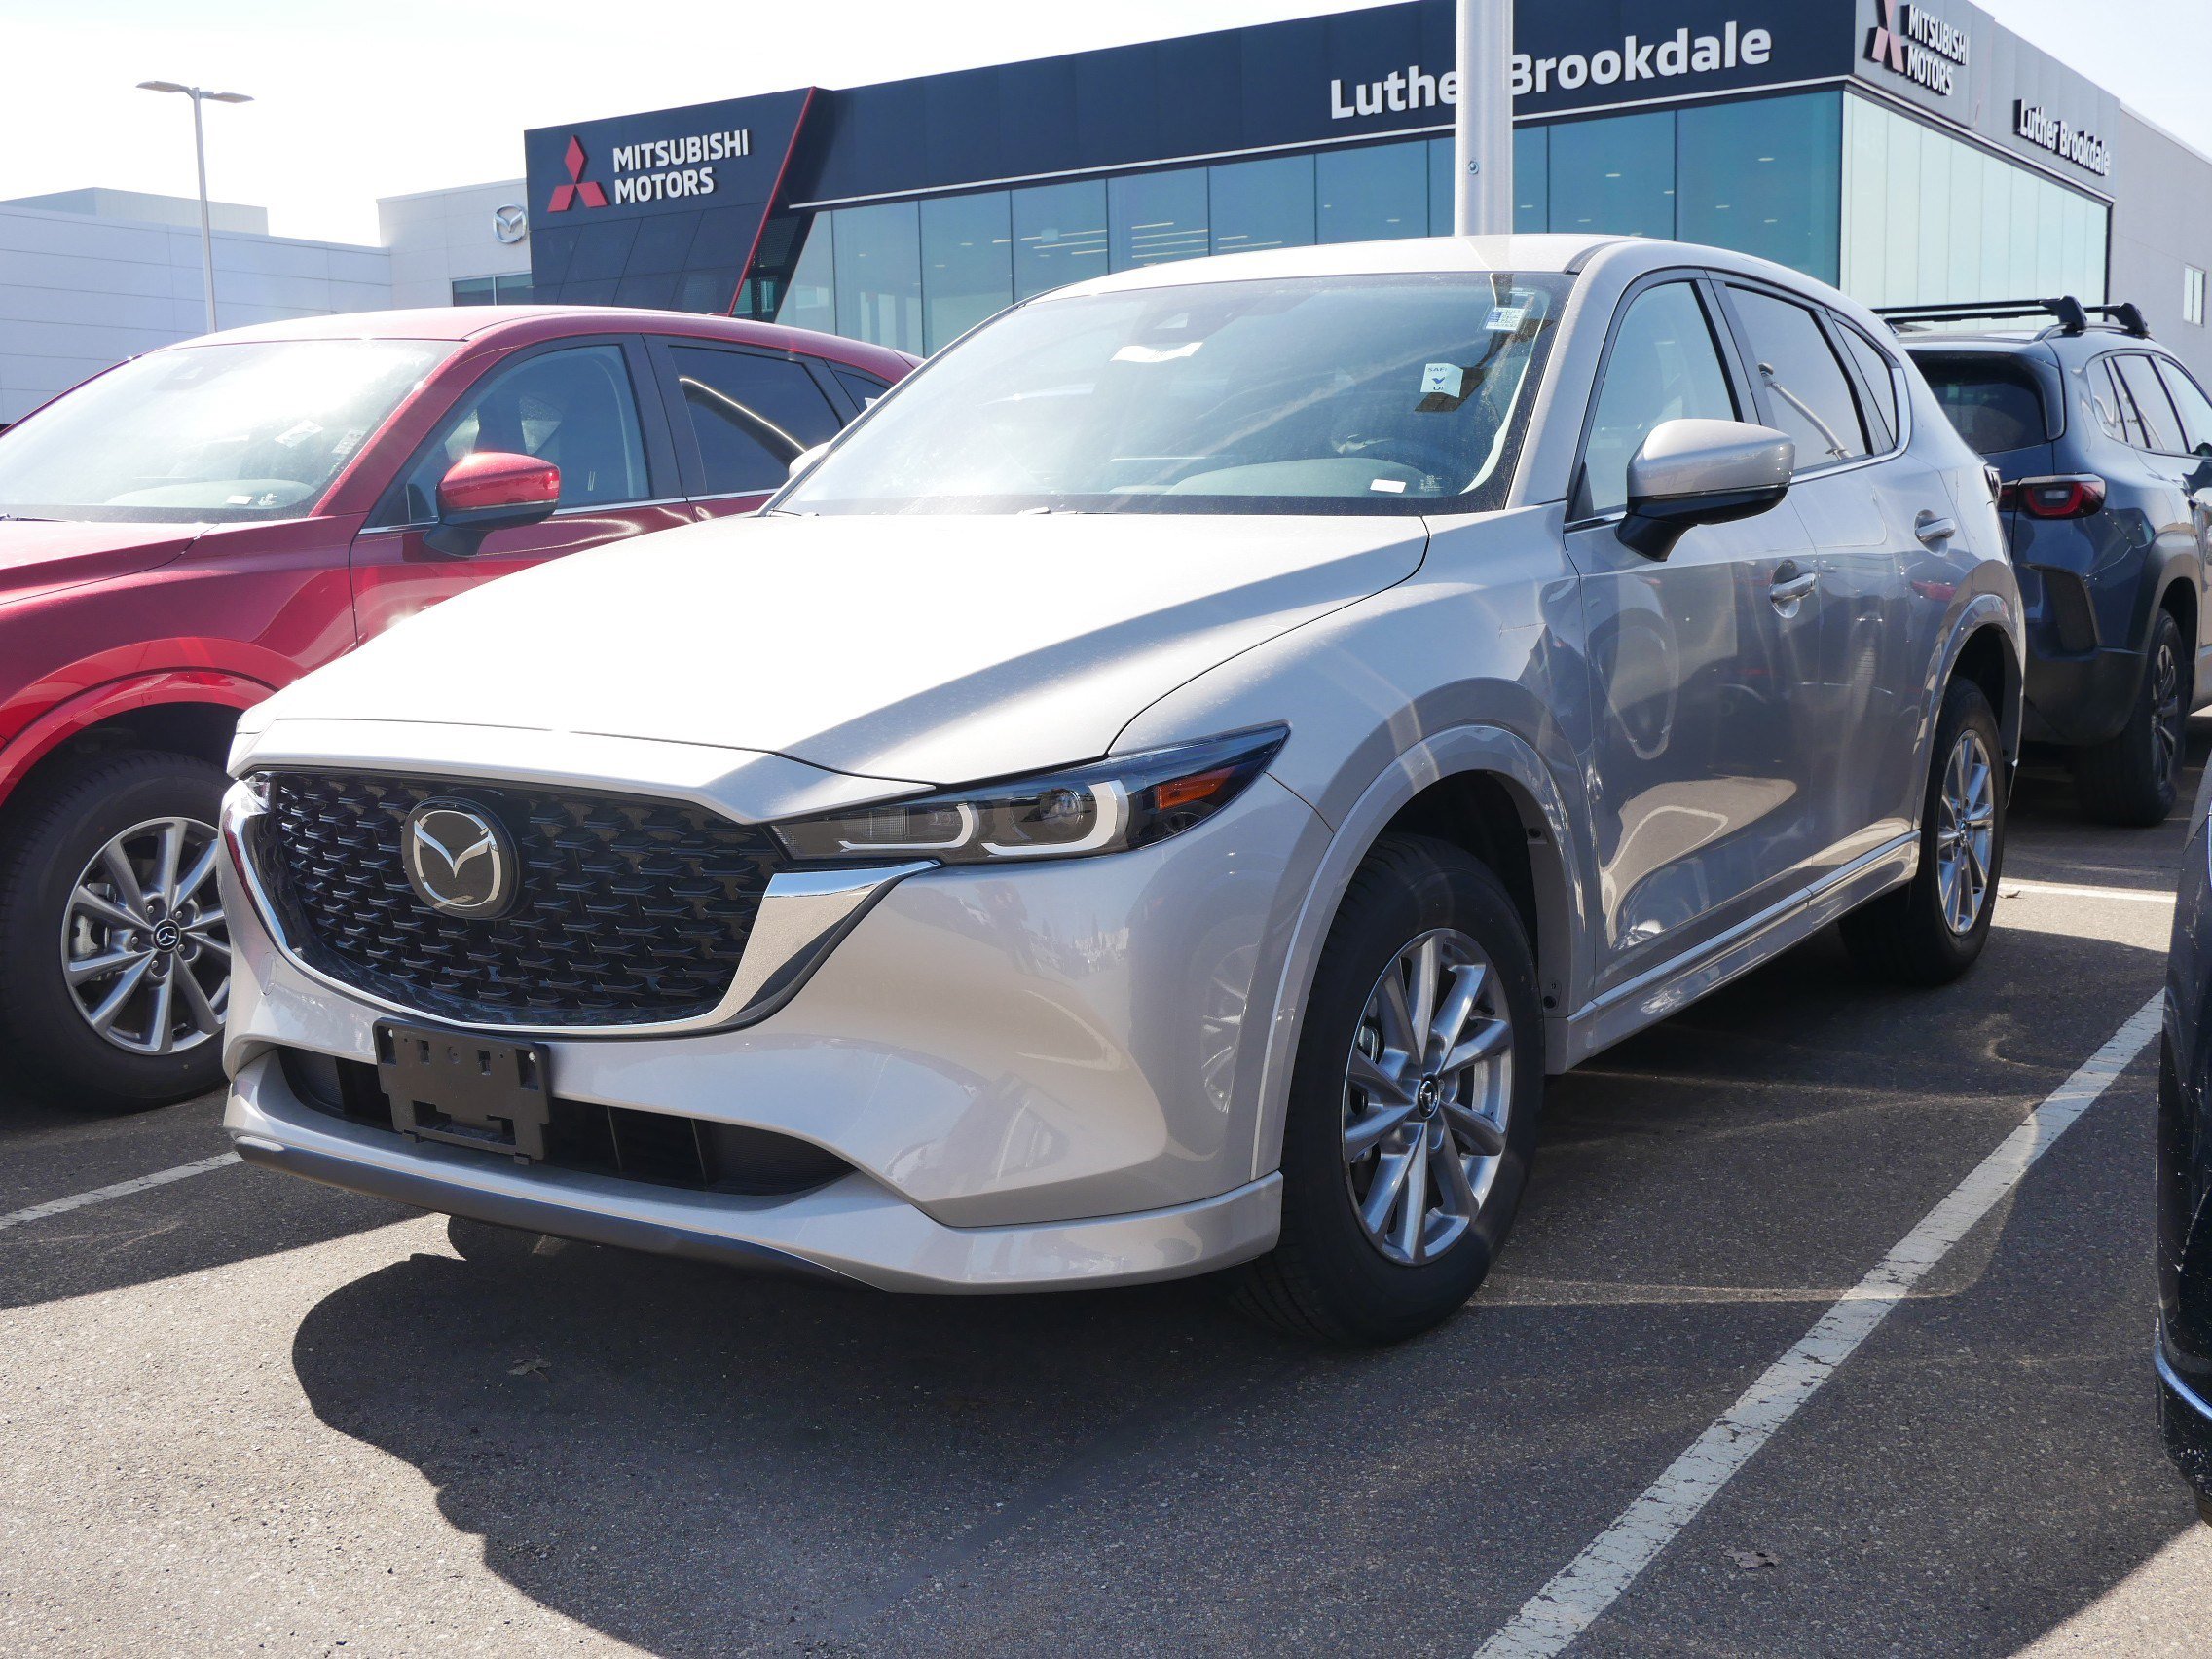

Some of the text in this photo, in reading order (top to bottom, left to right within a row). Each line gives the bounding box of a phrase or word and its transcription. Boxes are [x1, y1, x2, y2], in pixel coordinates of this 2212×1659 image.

[1908, 4, 1971, 65] MITSUBISHI
[1330, 20, 1772, 120] Luthe Brookdale
[1907, 45, 1953, 96] MOTORS
[613, 129, 750, 174] MITSUBISHI
[2019, 98, 2111, 176] Luther Brookdale
[614, 166, 715, 205] MOTORS
